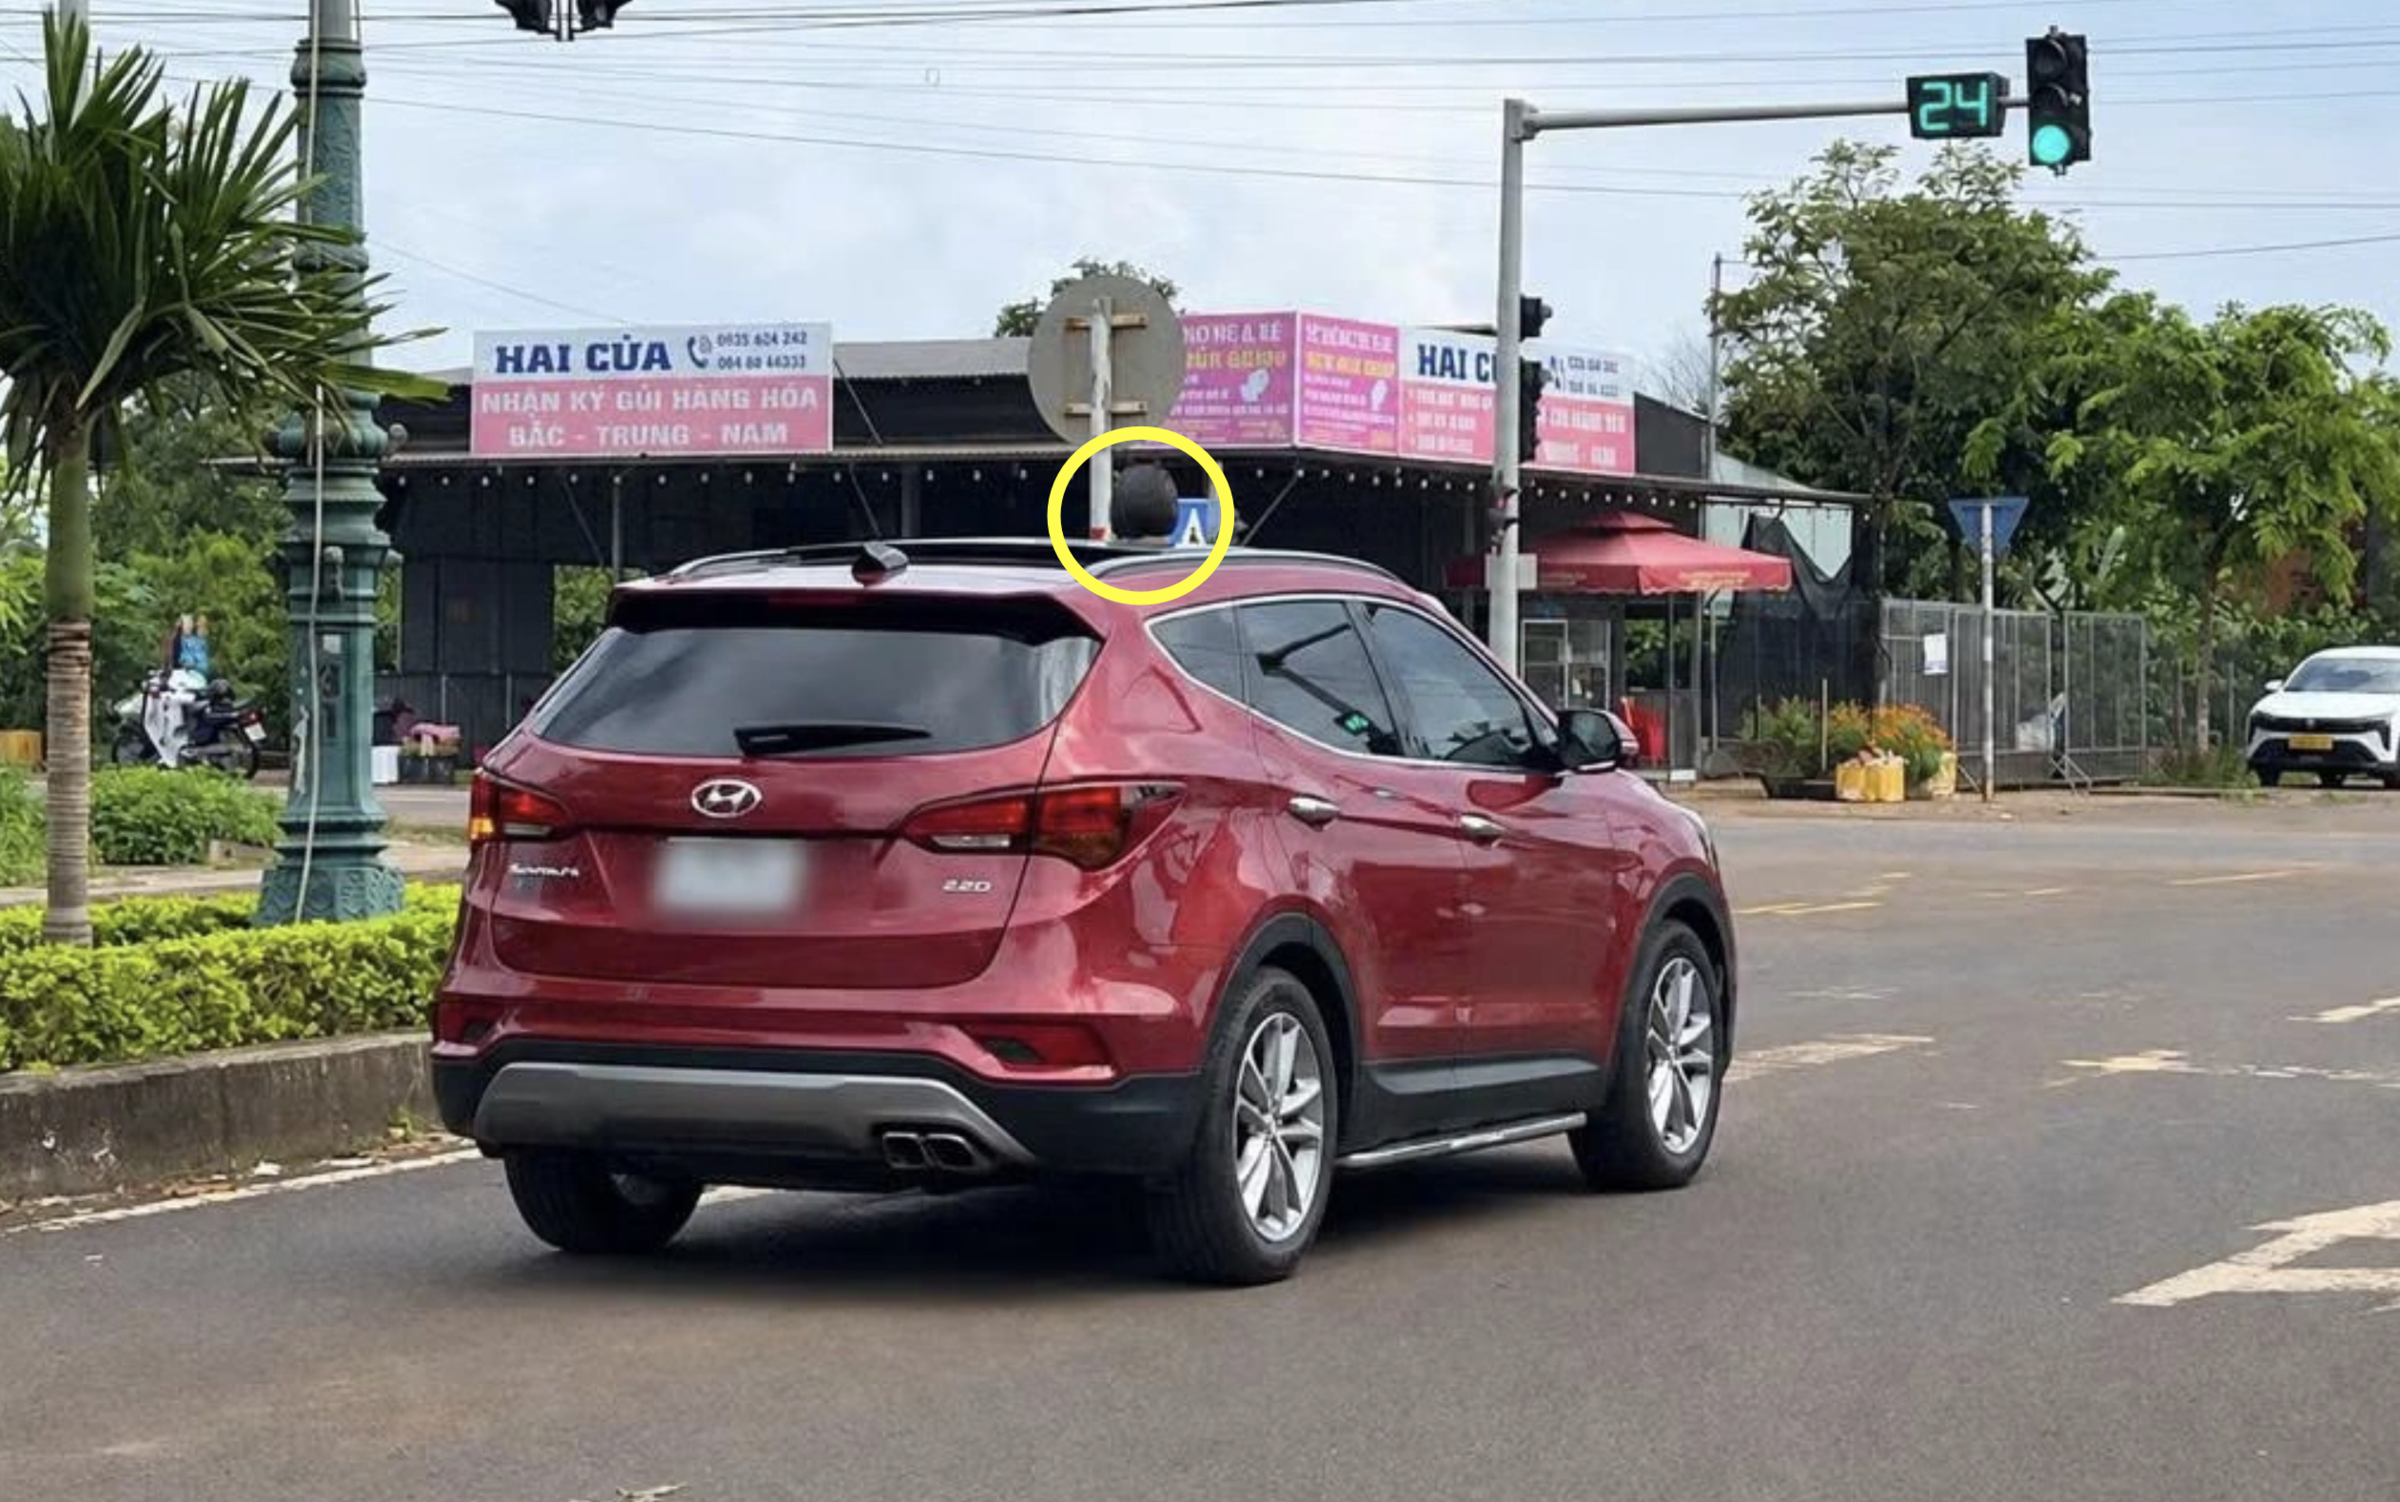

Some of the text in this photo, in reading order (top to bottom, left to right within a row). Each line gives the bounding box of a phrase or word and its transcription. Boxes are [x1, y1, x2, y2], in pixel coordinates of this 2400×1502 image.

[1919, 81, 1987, 131] 24
[496, 343, 571, 374] HAI
[1418, 343, 1467, 380] HAI
[482, 388, 560, 419] NHẬN
[570, 384, 605, 412] KÝ
[673, 384, 750, 410] HÀNG
[761, 381, 818, 410] HÓA
[509, 419, 565, 448] BẮC
[597, 424, 690, 447] TRUNG
[720, 421, 788, 446] NAM
